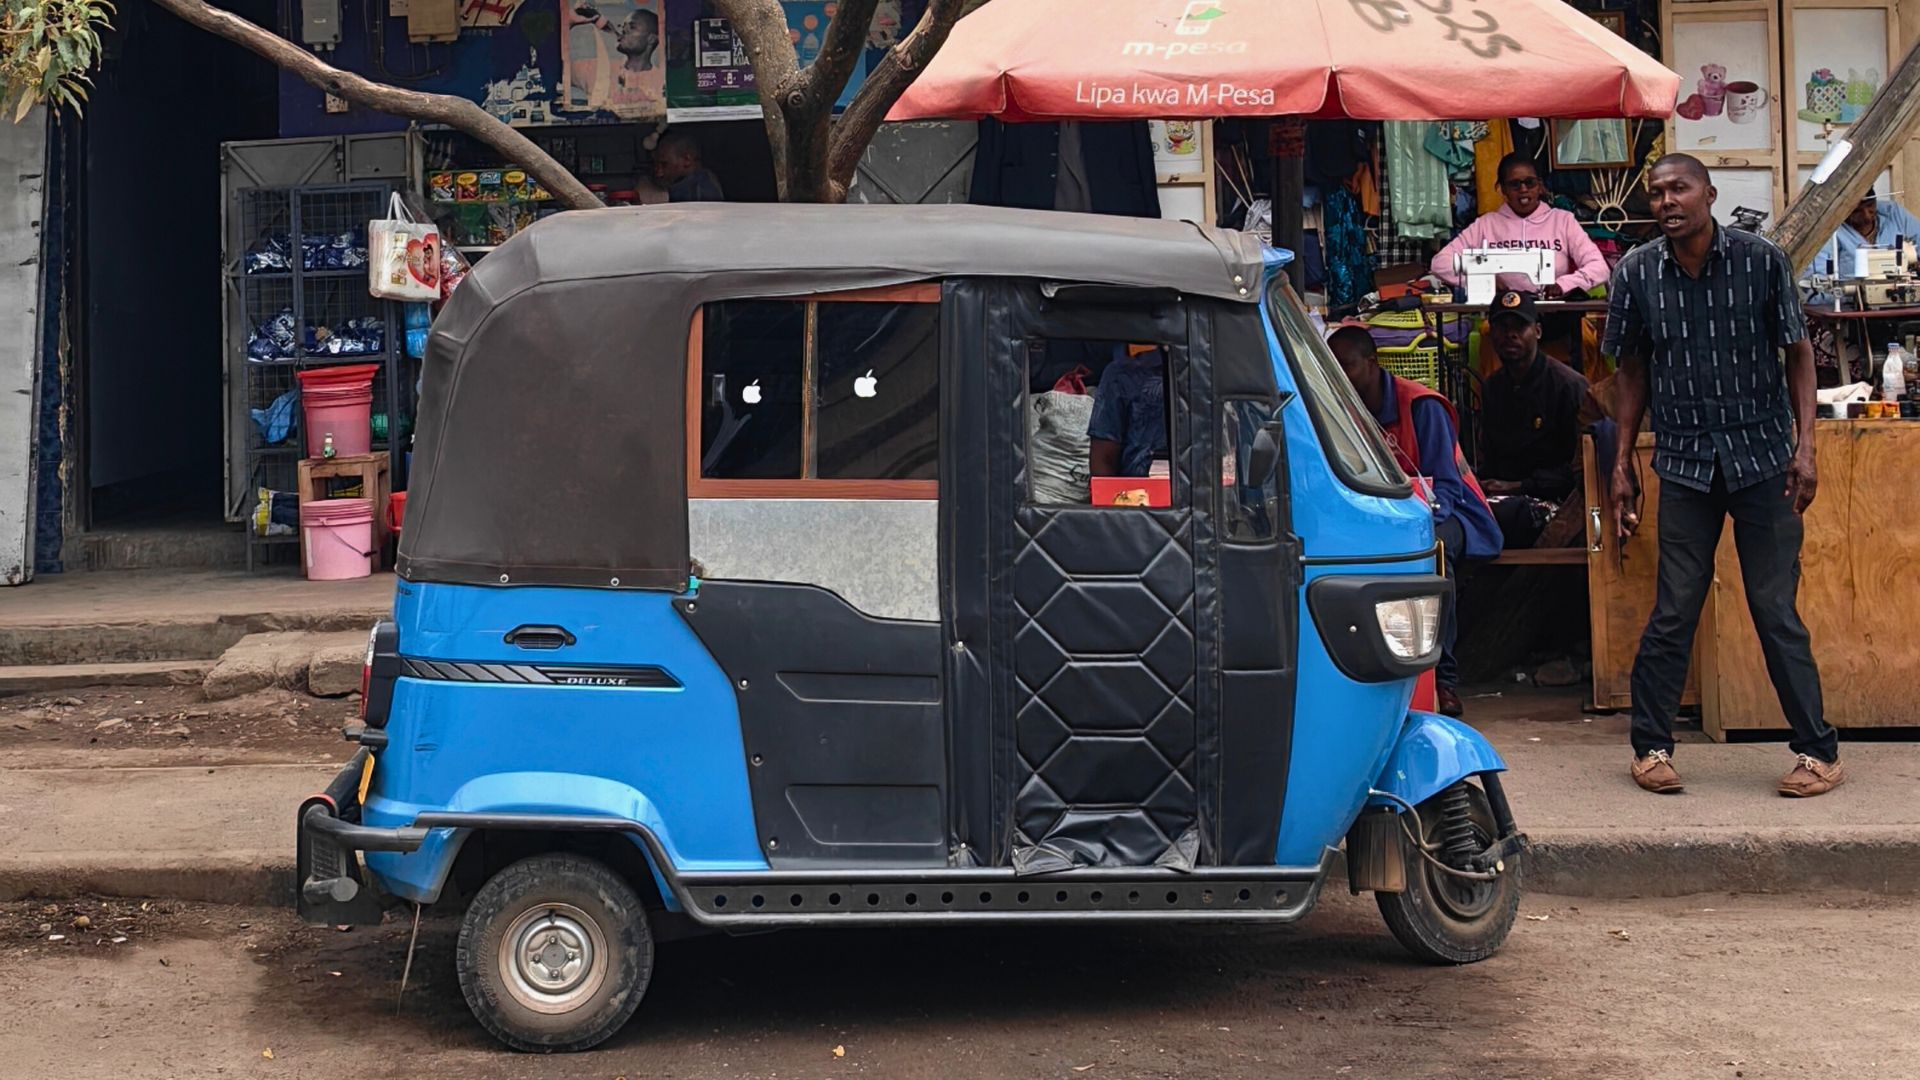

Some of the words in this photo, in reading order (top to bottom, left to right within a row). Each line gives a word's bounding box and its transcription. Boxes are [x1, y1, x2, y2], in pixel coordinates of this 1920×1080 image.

[1121, 40, 1248, 60] m-pesa
[1075, 81, 1126, 109] Lipa
[1132, 82, 1180, 105] kwa
[1186, 83, 1275, 106] M-Pesa
[1489, 238, 1562, 251] ESSENTIALS
[566, 677, 629, 686] DELUXE
